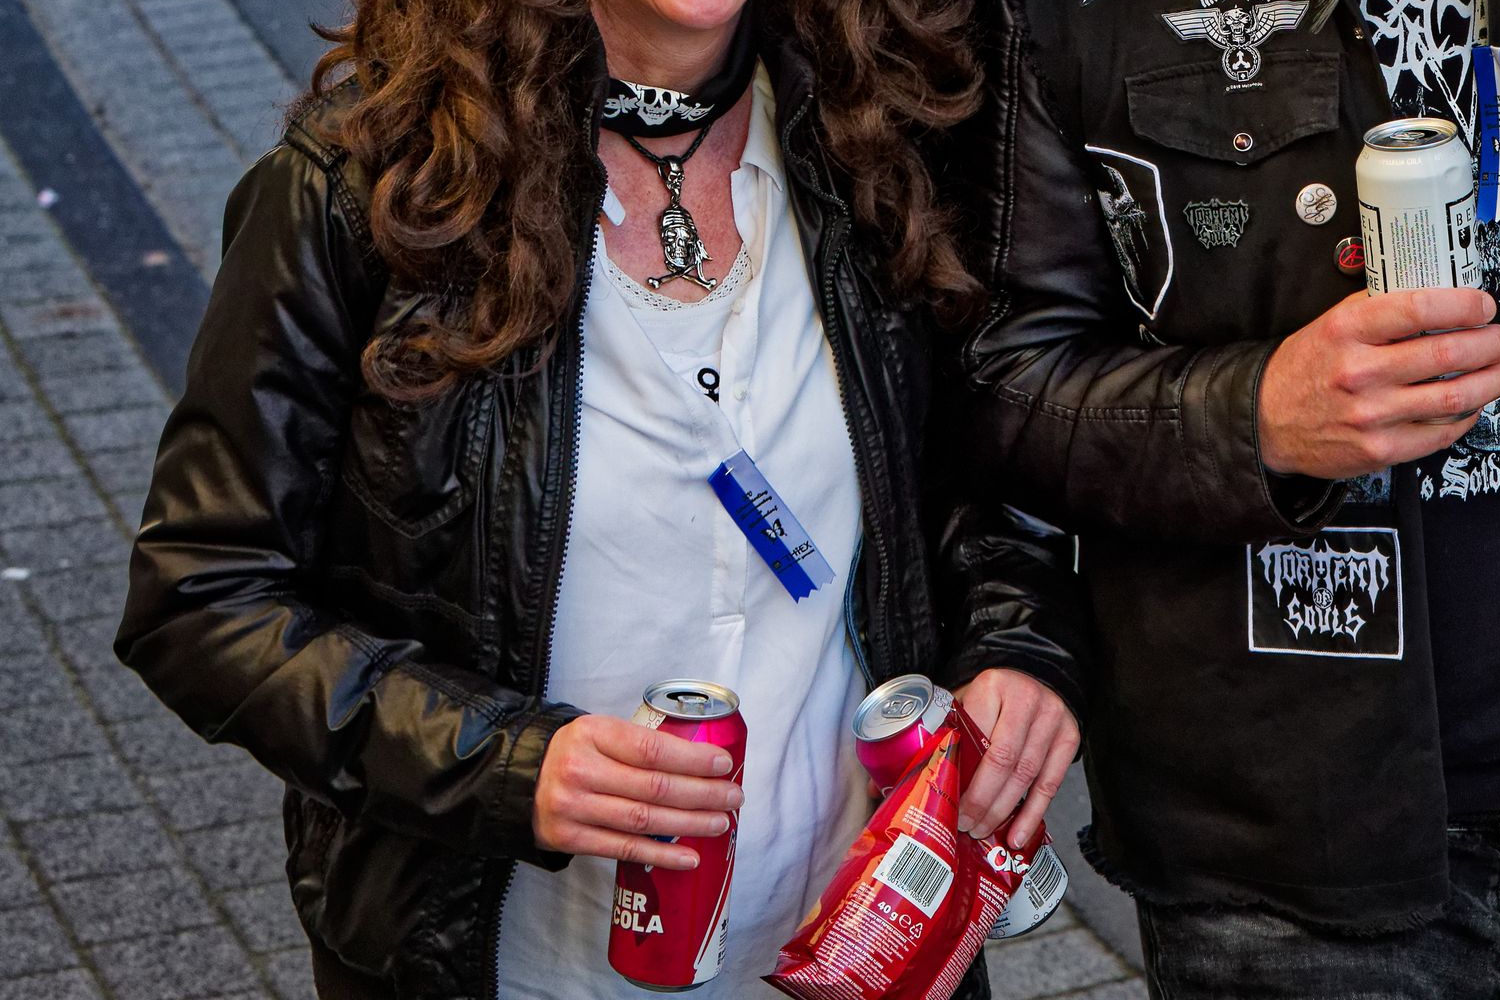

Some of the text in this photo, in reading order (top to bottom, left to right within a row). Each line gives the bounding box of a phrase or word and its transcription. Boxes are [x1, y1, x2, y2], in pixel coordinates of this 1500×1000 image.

[1256, 538, 1390, 613] TORMENT
[1283, 592, 1367, 643] SOULS
[613, 905, 665, 934] COLA
[877, 901, 892, 914] 40
